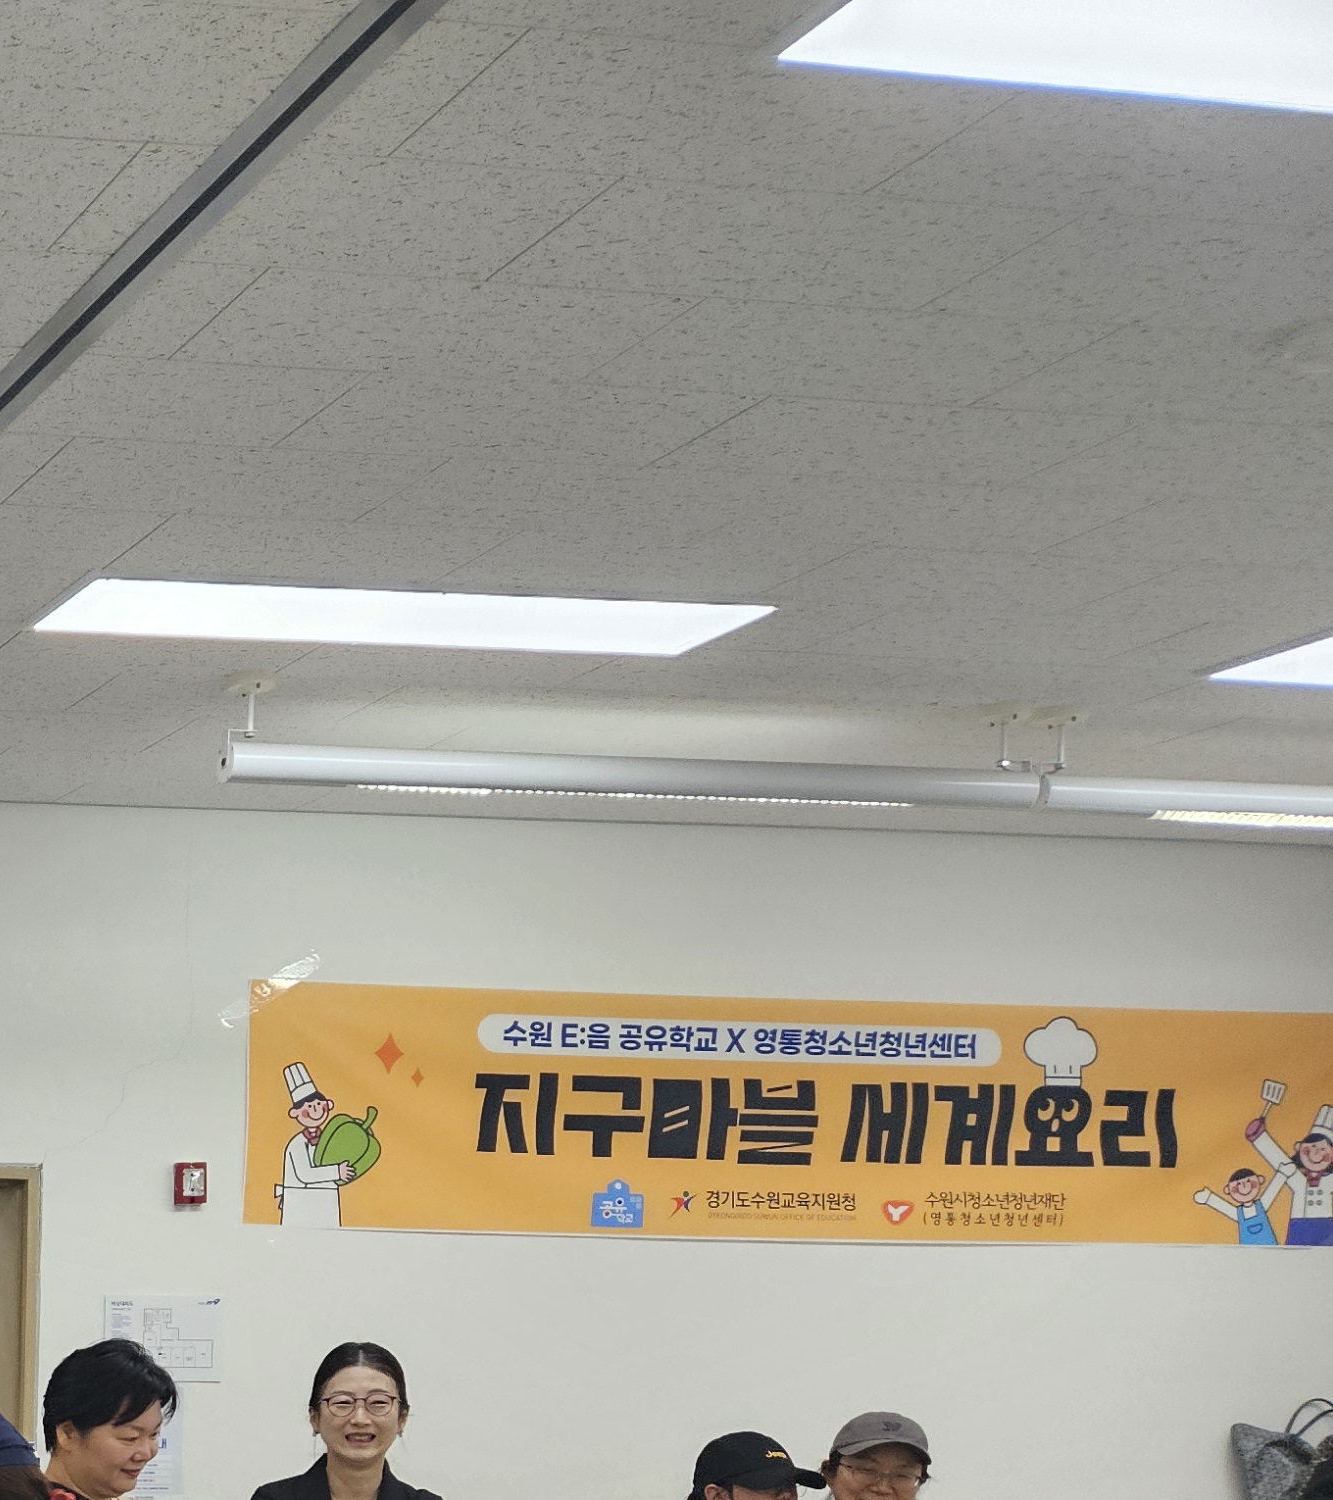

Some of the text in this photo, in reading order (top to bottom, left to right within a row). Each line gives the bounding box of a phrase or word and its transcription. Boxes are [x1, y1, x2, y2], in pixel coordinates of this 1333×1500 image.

[503, 1020, 977, 1060] 수원 E:음 공유학교 X 영통청소년청년센터
[474, 1071, 1179, 1169] 지구마블 세계요리
[705, 1190, 857, 1212] 경기도수원교육지원청
[925, 1191, 1067, 1211] 수원시청소년청년재단
